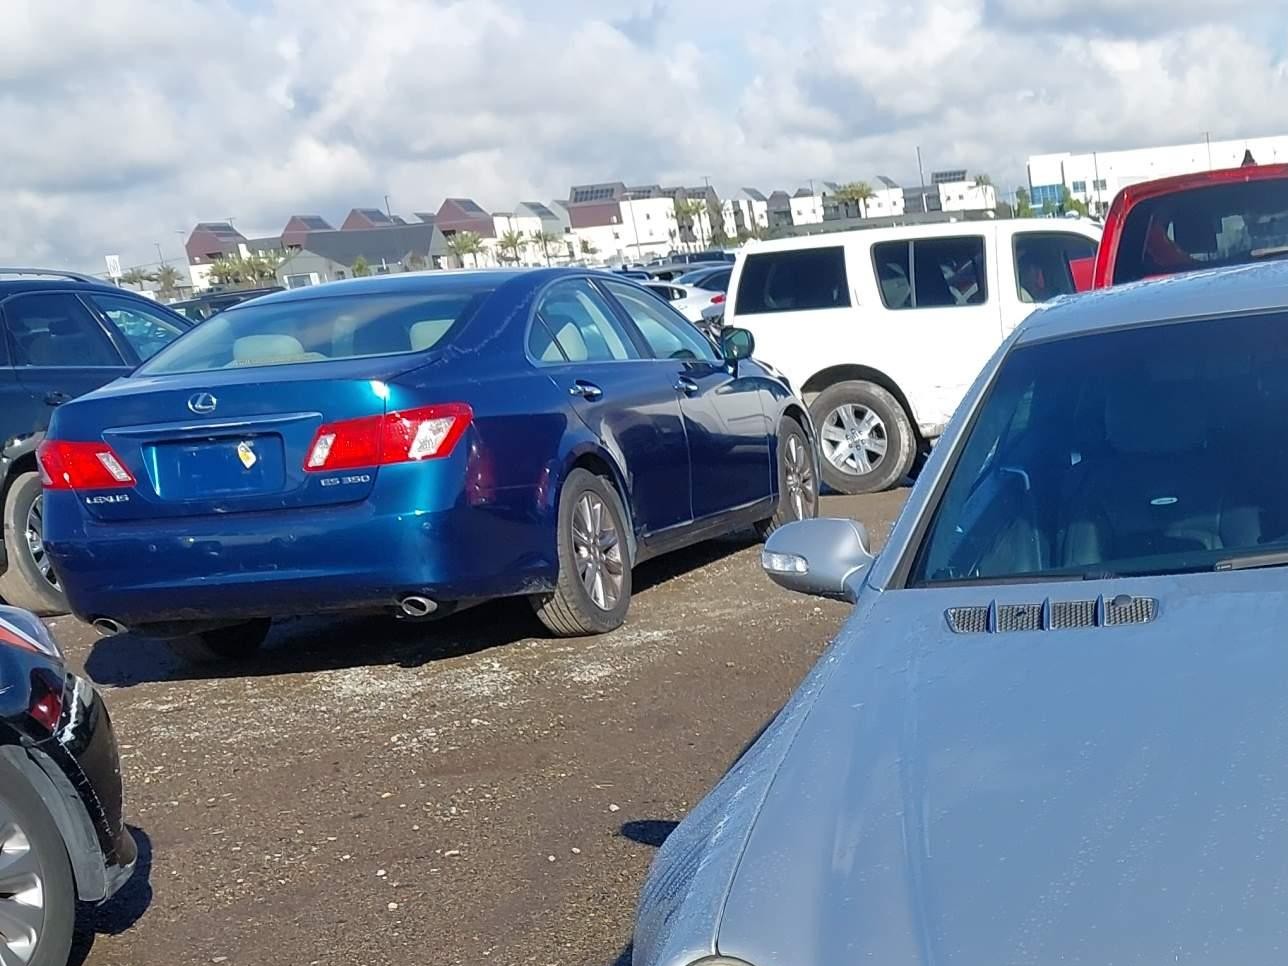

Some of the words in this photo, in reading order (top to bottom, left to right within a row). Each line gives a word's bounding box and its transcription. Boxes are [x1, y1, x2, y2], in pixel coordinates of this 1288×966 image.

[320, 477, 340, 487] ES
[341, 474, 370, 485] 350
[86, 494, 130, 504] LEXUS
